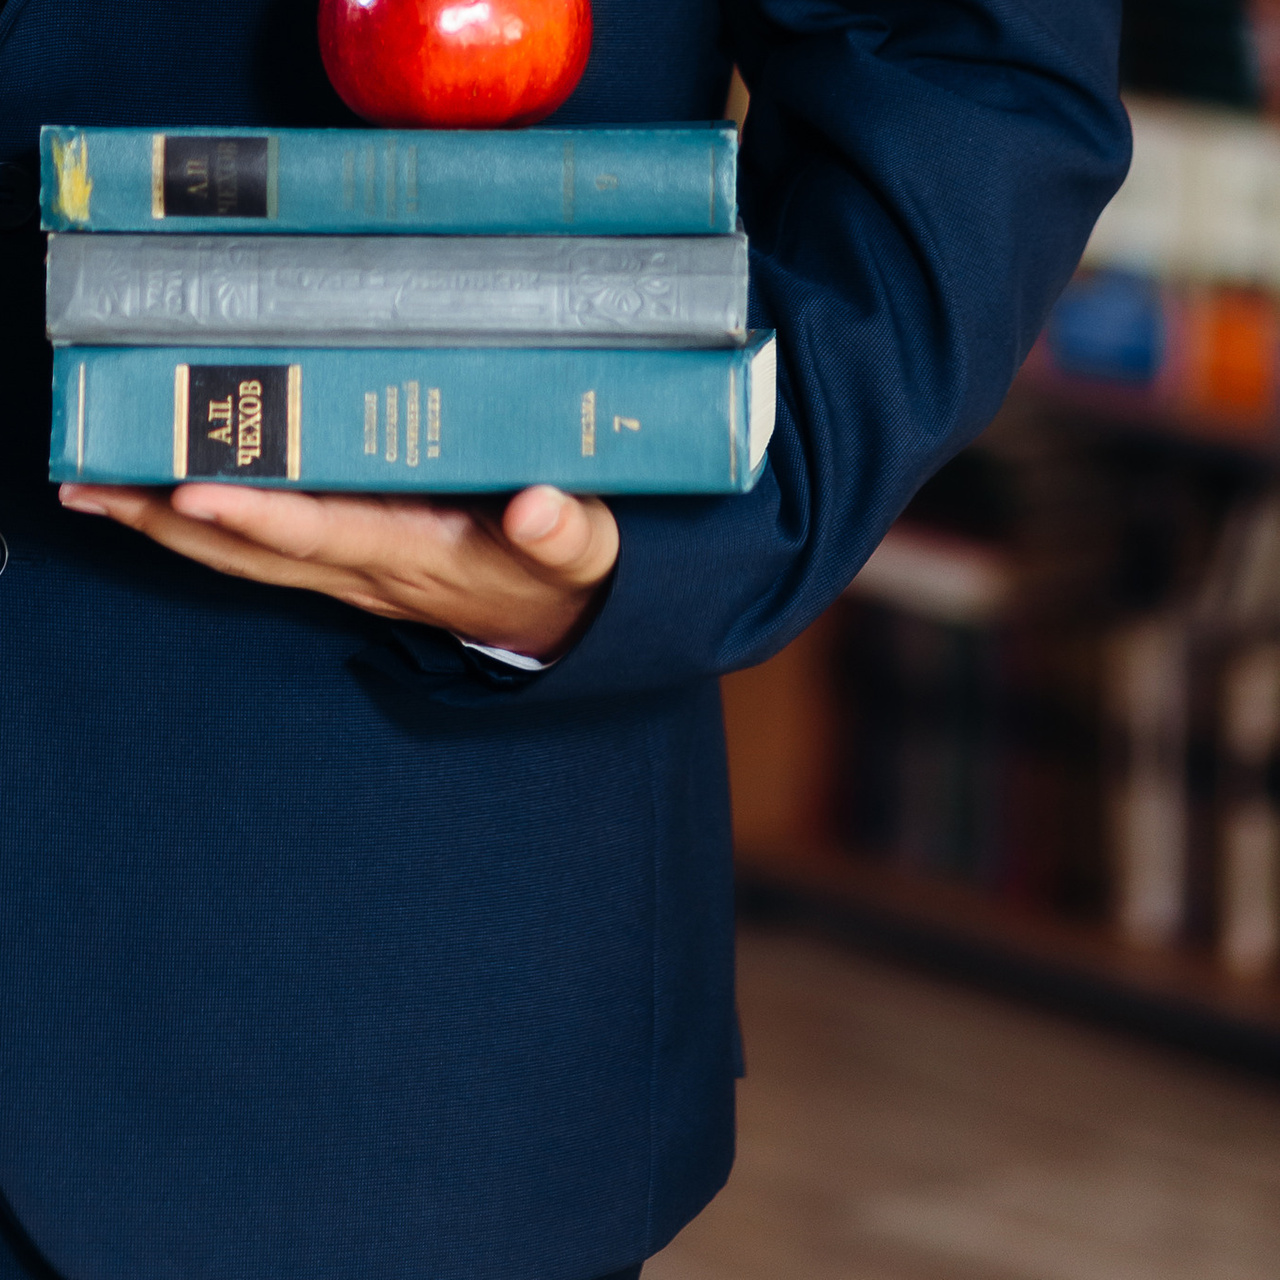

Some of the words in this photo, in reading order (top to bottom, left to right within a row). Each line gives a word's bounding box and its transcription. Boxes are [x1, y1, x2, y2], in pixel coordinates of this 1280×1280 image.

[207, 395, 232, 445] А.П.
[237, 380, 261, 467] ЧЕХОВ
[614, 415, 641, 434] 7
